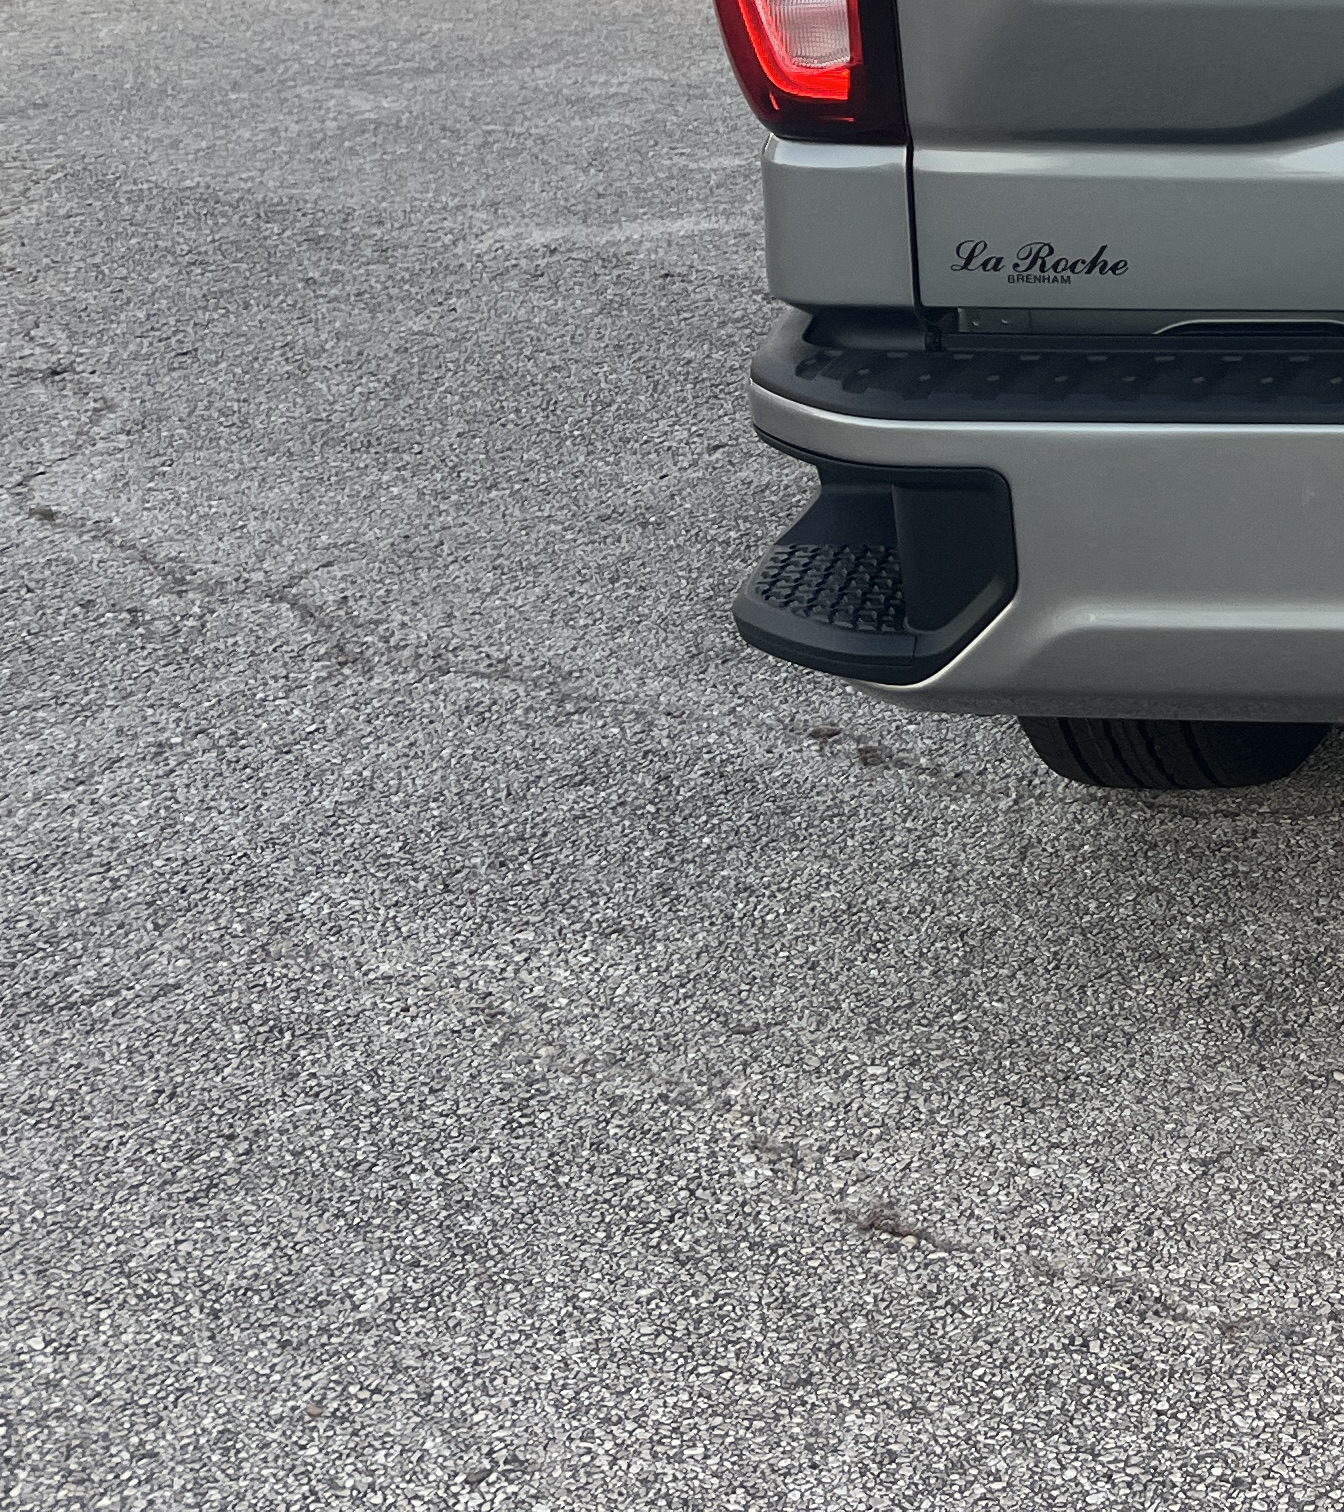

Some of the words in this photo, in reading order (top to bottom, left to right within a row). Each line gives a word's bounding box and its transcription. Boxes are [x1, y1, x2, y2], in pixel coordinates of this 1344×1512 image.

[950, 239, 1006, 273] La
[1011, 240, 1129, 276] Roche
[1006, 274, 1072, 285] BRENHAM
